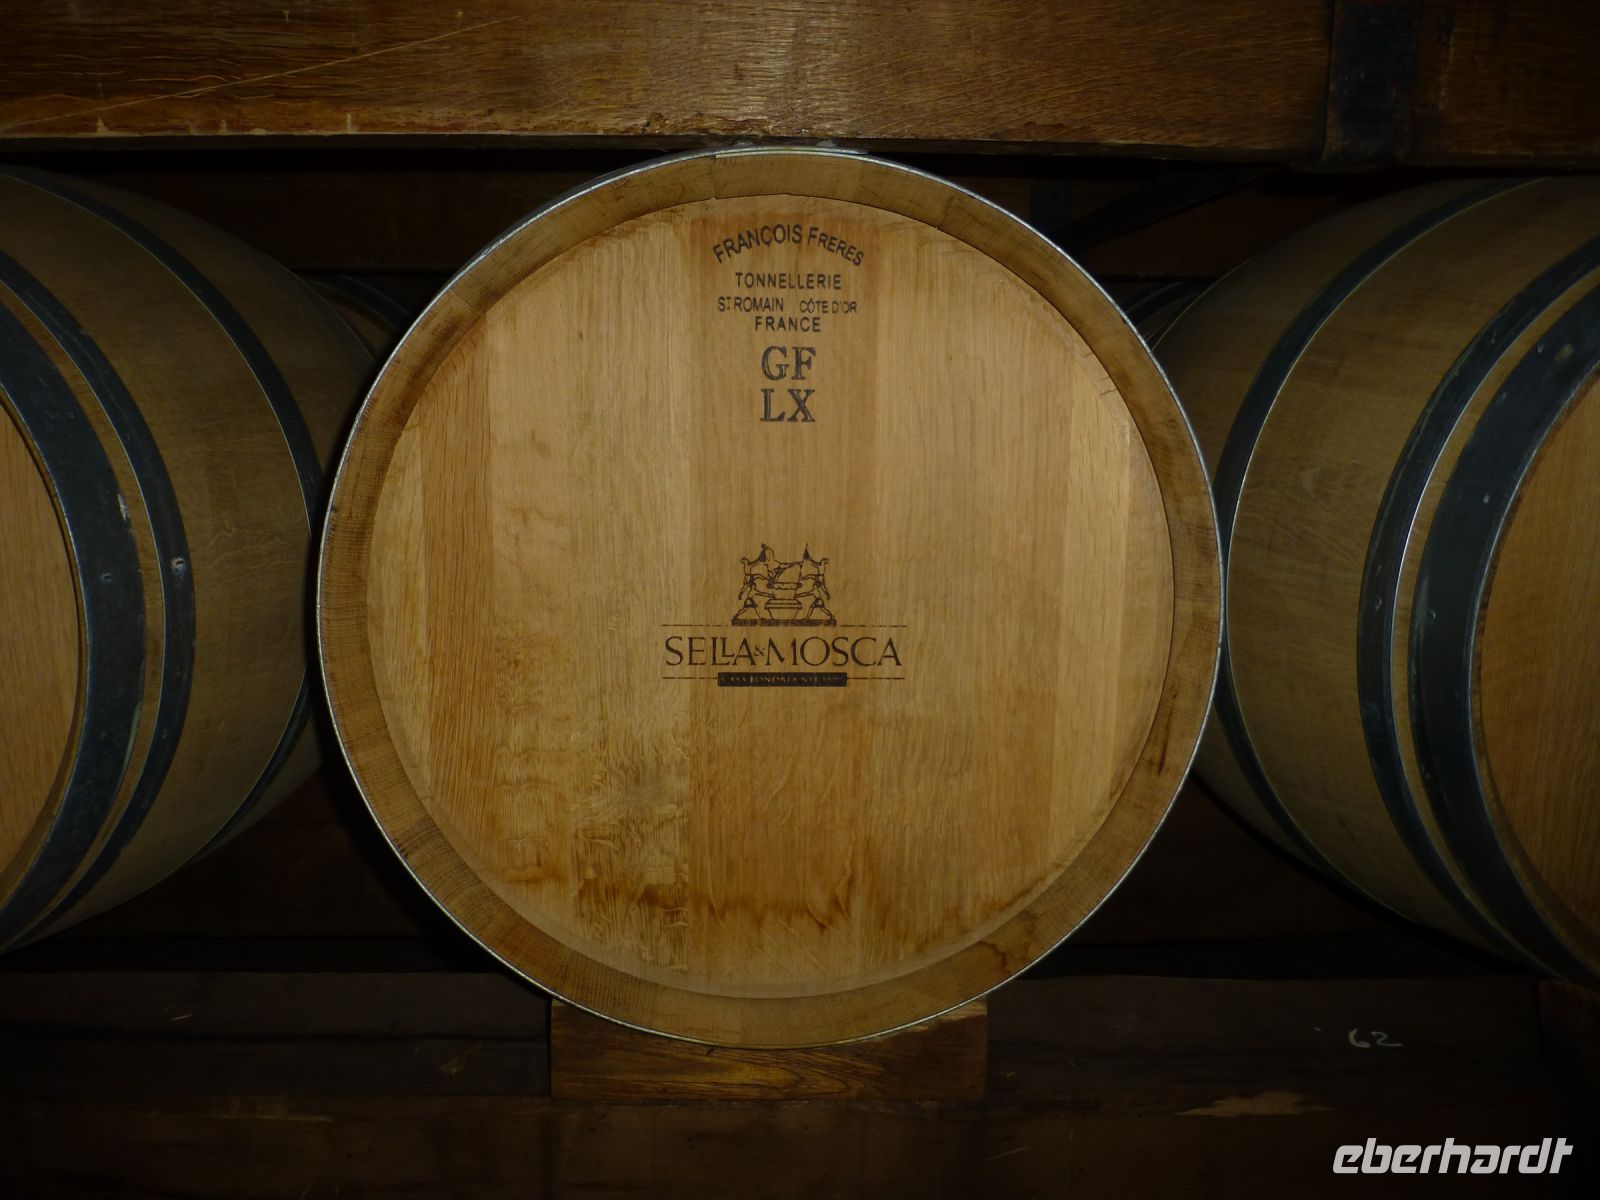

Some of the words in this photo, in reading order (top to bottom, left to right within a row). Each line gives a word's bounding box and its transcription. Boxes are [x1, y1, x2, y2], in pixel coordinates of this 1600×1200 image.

[712, 224, 803, 264] FRANÇOIS
[807, 226, 864, 266] FRERES
[735, 272, 842, 289] TONNELLERIE
[755, 316, 821, 332] FRANCE
[761, 345, 817, 381] GF
[760, 388, 816, 423] LX
[1347, 1027, 1404, 1049] 62
